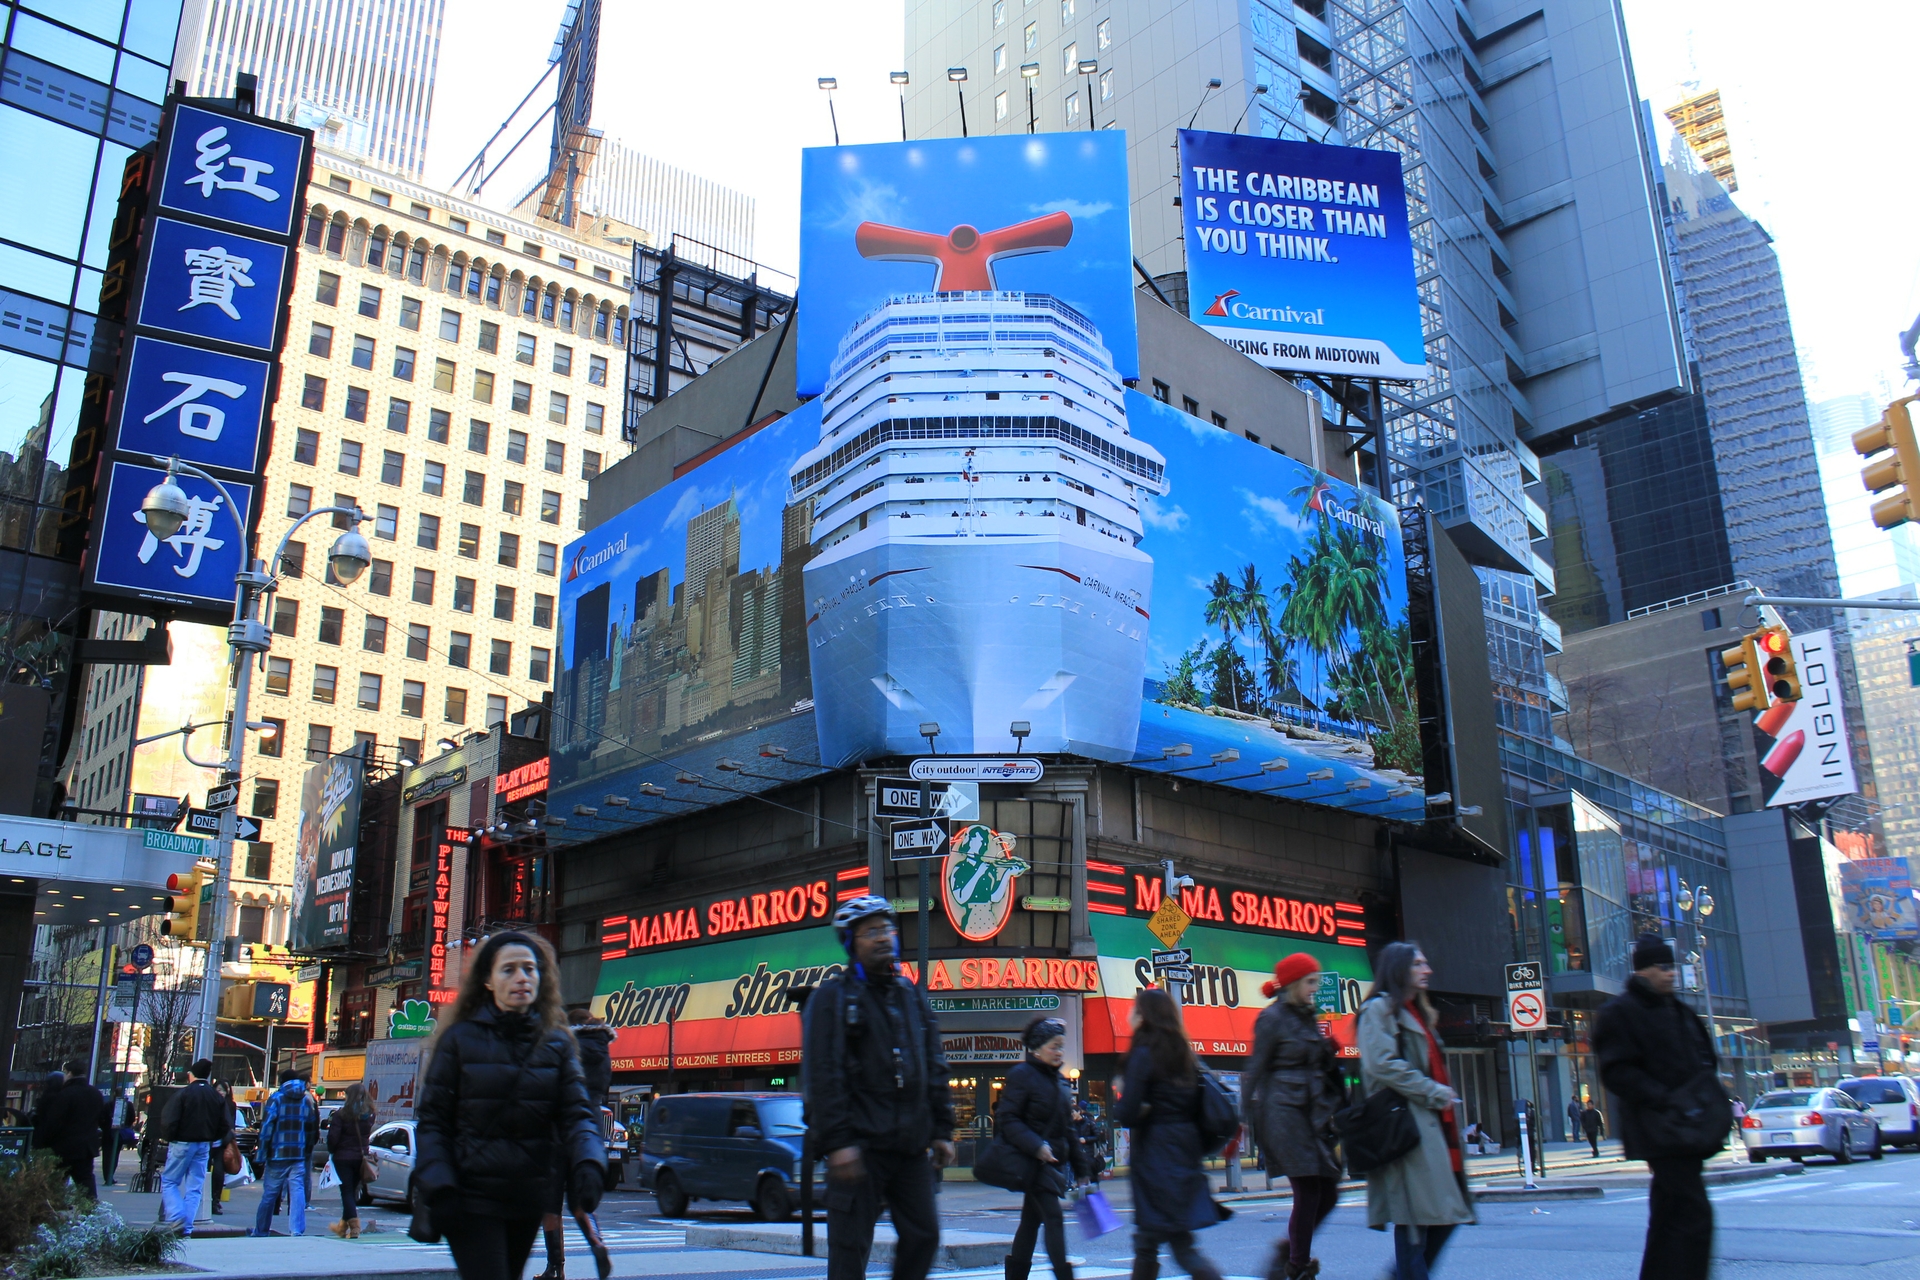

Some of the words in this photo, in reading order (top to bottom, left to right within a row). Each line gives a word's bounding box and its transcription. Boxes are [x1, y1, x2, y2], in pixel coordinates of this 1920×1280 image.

[1192, 166, 1240, 194] THE
[1245, 172, 1380, 208] CARIBBEAN
[1196, 196, 1219, 222] IS
[1228, 200, 1315, 231] CLOSER
[1321, 208, 1387, 239] THAN
[1195, 226, 1247, 255] YOU
[1255, 231, 1339, 264] THINK.
[1232, 301, 1325, 326] Carnival
[1273, 342, 1310, 360] FROM
[1315, 346, 1381, 366] MIDTOWN
[1325, 499, 1386, 539] Carnival
[580, 531, 629, 575] Carnival
[840, 578, 865, 602] MIRACLE
[1083, 576, 1111, 598] CARNIVAL
[1114, 590, 1136, 609] MIRACLE
[1800, 642, 1843, 778] INGLOT
[494, 756, 550, 795] PLAYWRIG
[917, 765, 934, 776] city
[937, 764, 976, 774] outdoor
[982, 766, 1037, 774] INTERSTATE
[209, 794, 219, 804] ONE
[220, 790, 232, 801] WAY
[506, 778, 549, 803] RESTAURANT
[890, 790, 918, 807] ONE
[930, 792, 962, 809] WAY
[195, 816, 216, 829] ONE
[146, 831, 201, 854] BROADWAY
[445, 829, 469, 842] THE
[898, 832, 915, 848] ONE
[921, 829, 940, 846] WAY
[0, 838, 73, 859] LACE
[330, 850, 345, 871] NOW
[344, 846, 354, 867] ON
[316, 868, 352, 896] WEDNESDAYS
[433, 844, 451, 986] PLAYWRIGHT
[628, 907, 701, 949] MAMA
[707, 880, 829, 936] SBARRO'S
[1134, 874, 1225, 922] MMA
[1231, 890, 1336, 937] SBARRO'S
[1156, 914, 1181, 924] SHARED
[1161, 923, 1177, 931] ZONE
[1160, 930, 1180, 938] AHEAD
[960, 957, 1099, 991] SBARRO'S
[1508, 982, 1523, 990] BIKE
[1524, 980, 1541, 988] PATH
[428, 990, 458, 1003] TAVE
[604, 981, 692, 1029] sbarro
[928, 998, 956, 1011] ERIA
[974, 1035, 1023, 1051] RESTAURANT
[1212, 1042, 1247, 1053] SALAD
[610, 1058, 635, 1069] PASTA
[640, 1056, 670, 1068] SALAD
[676, 1054, 719, 1067] CALZONE
[725, 1052, 771, 1064] ENTREES
[778, 1050, 803, 1061] ESPR
[999, 1052, 1020, 1060] WINE
[770, 1078, 785, 1086] ATM
